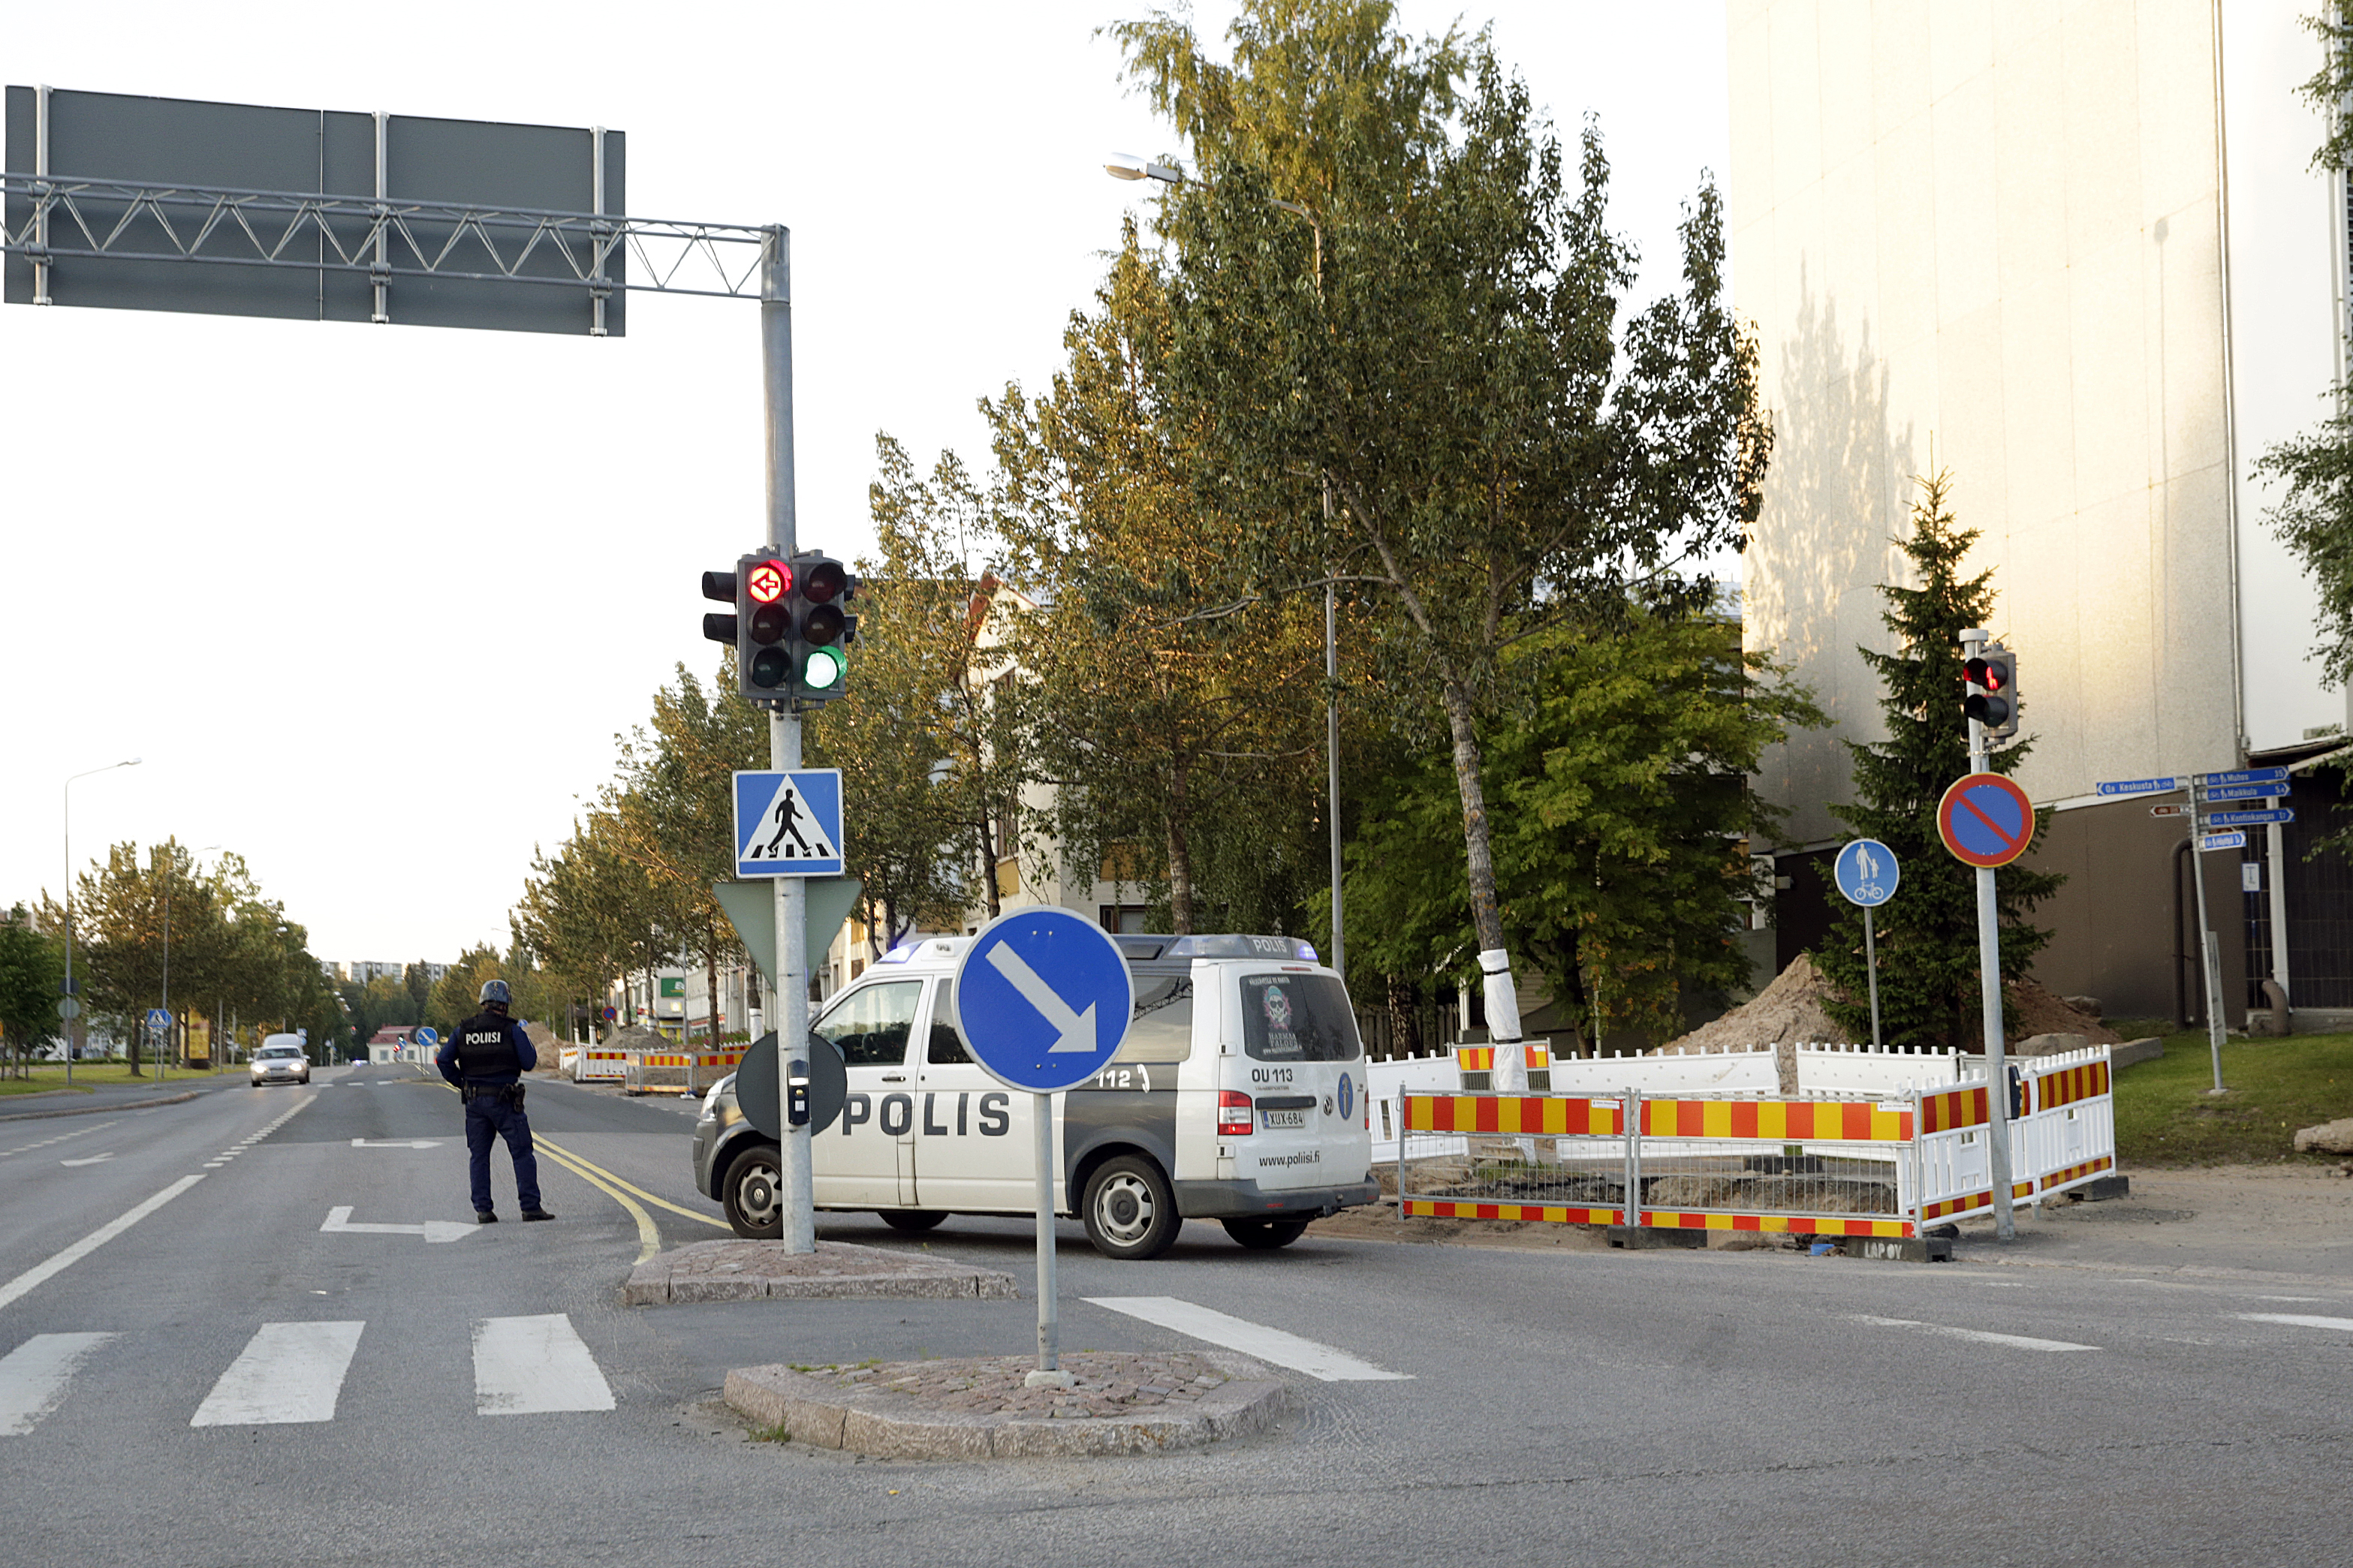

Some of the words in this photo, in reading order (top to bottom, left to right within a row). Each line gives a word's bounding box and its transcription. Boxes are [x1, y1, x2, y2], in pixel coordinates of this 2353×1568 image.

[2119, 781, 2153, 792] Keskusta
[2227, 787, 2258, 797] Maikkula
[1252, 939, 1288, 953] POLIS
[465, 1031, 501, 1046] POLIISI
[1095, 1070, 1131, 1088] 112
[1252, 1068, 1270, 1082] OU
[1273, 1068, 1293, 1082] 113
[842, 1093, 1010, 1136] POLIS
[1270, 1110, 1303, 1125] XUX-684
[1259, 1151, 1320, 1168] www.poliisi.fi
[1864, 1241, 1886, 1259] LAP
[1887, 1243, 1903, 1260] OY
